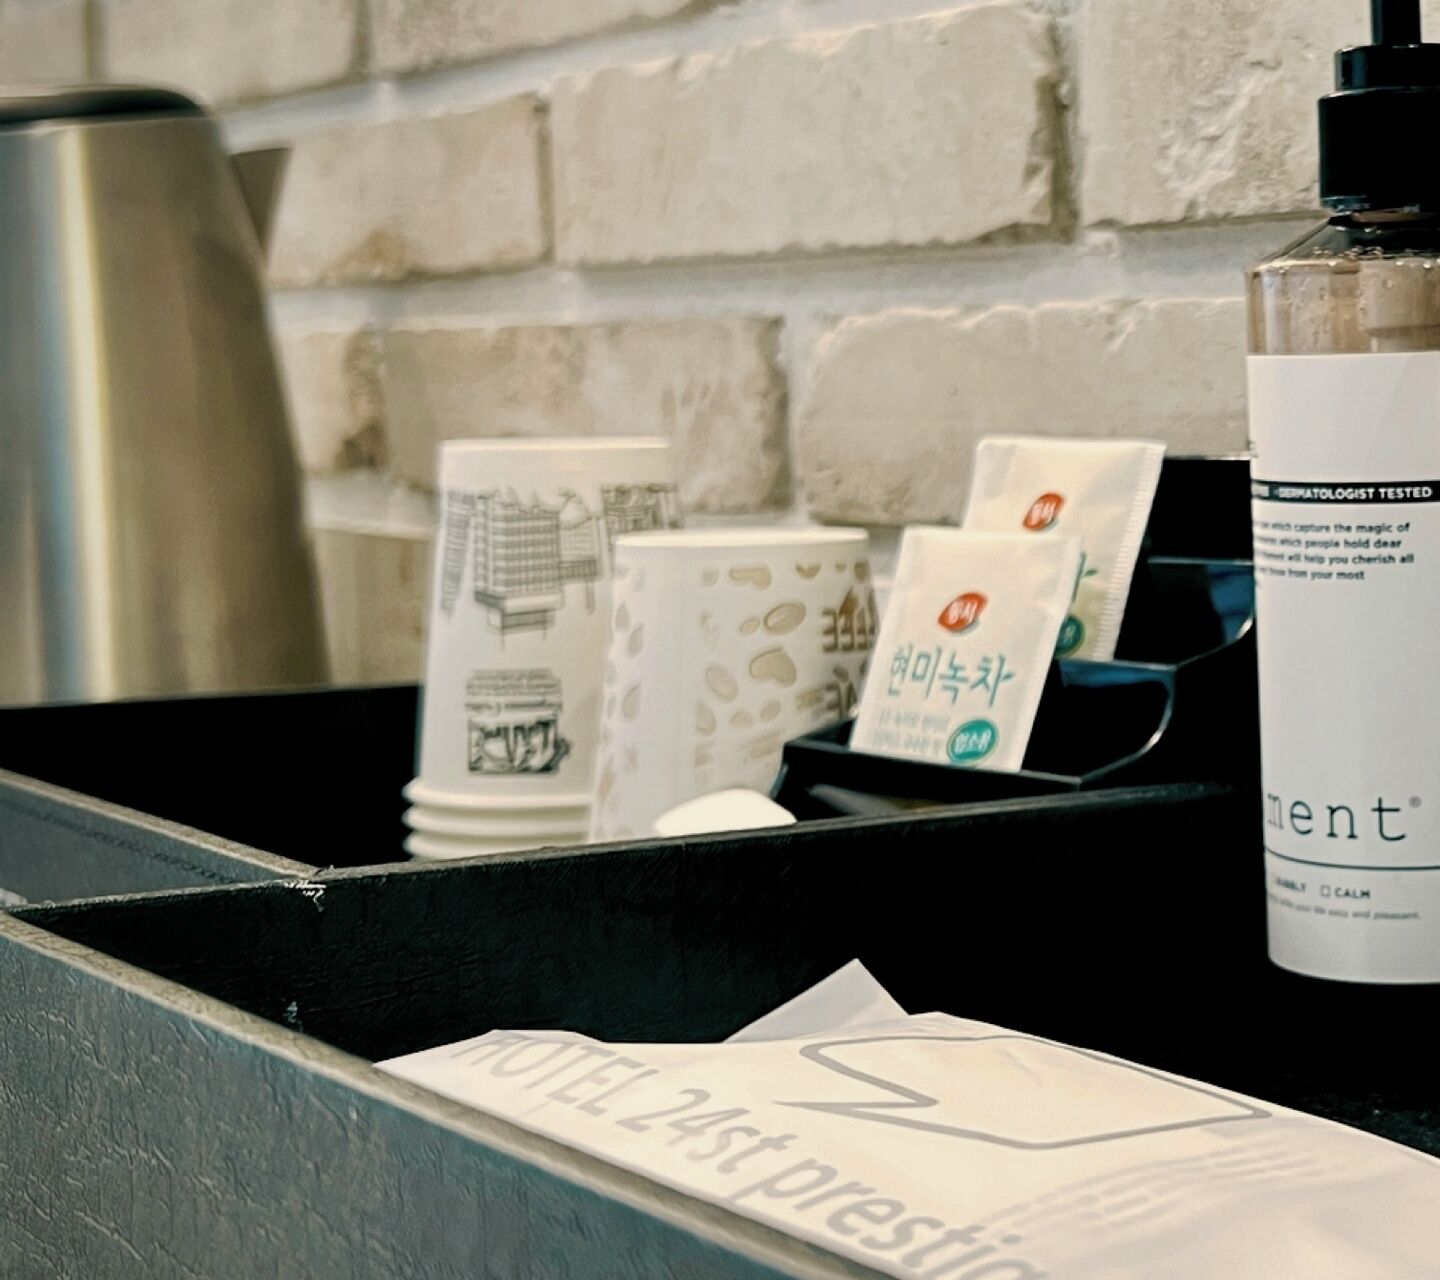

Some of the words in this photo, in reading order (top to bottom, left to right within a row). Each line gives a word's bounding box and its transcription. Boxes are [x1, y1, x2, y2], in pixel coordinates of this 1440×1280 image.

[1278, 486, 1374, 500] DERMATOLOGIST
[1378, 486, 1433, 499] TESTED
[1334, 523, 1352, 533] the
[1356, 523, 1393, 535] magic
[1396, 522, 1411, 532] of
[1343, 539, 1370, 548] hold
[1373, 539, 1402, 548] dear
[1328, 556, 1348, 566] you
[1351, 554, 1396, 564] cherish
[1399, 553, 1414, 563] all
[1336, 570, 1365, 580] most
[888, 642, 1015, 709] 현미녹차
[1335, 884, 1371, 899] CALM
[450, 1034, 660, 1117] HOTEL
[615, 1088, 798, 1175] 24st
